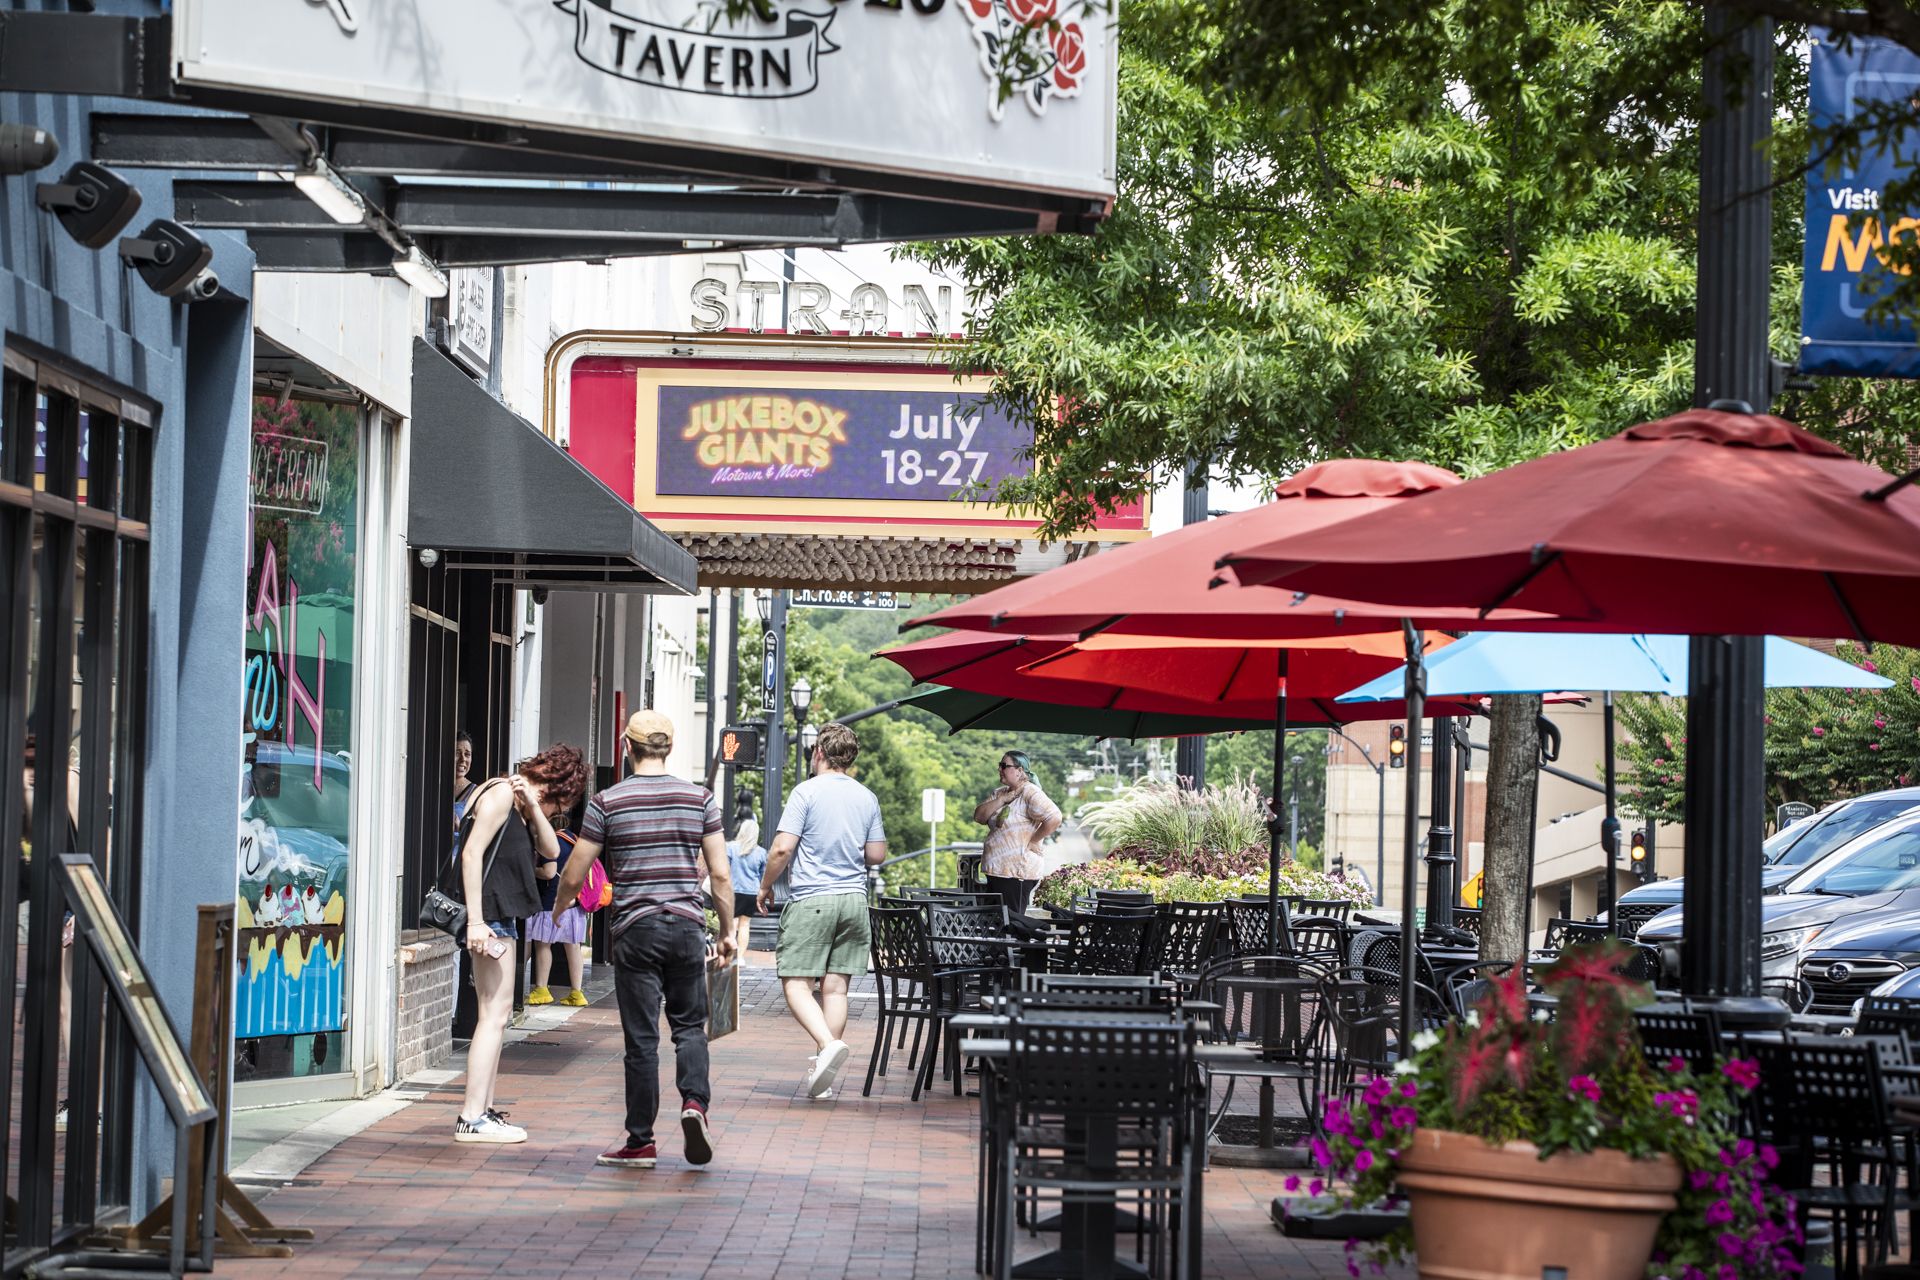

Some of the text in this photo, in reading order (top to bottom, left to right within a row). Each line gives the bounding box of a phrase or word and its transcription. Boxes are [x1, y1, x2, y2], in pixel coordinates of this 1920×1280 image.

[610, 23, 792, 88] TAVERN
[1828, 187, 1879, 210] Visit
[683, 397, 847, 442] JUKEBOX
[888, 403, 981, 451] July
[699, 431, 831, 468] GIANTS
[881, 449, 989, 485] 18-27
[250, 444, 325, 503] ICE CREAM
[711, 462, 819, 484] Motown & More!
[878, 598, 894, 608] 100
